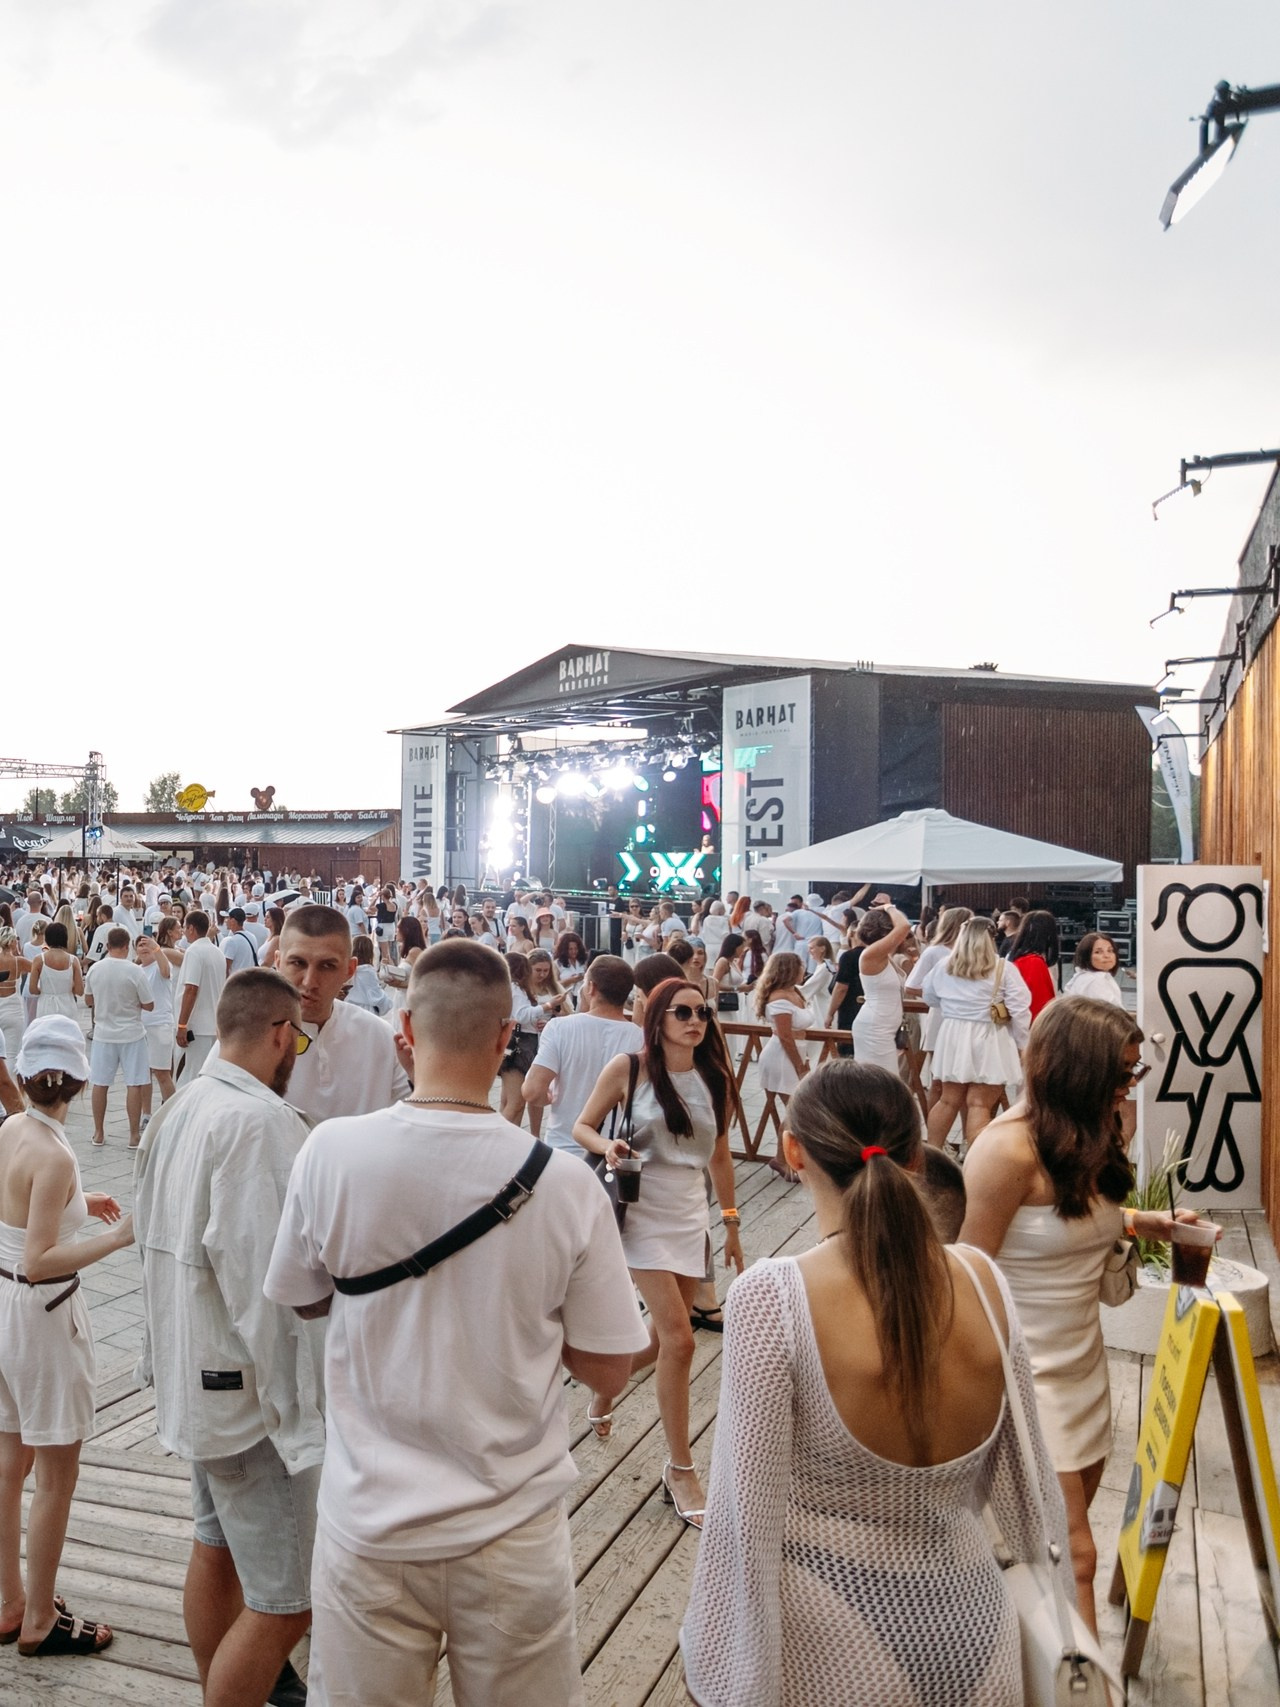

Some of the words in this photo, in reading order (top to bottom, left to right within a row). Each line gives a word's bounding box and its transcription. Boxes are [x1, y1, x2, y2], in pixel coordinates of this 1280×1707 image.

[559, 651, 611, 680] BARHAT
[735, 702, 796, 730] BARHAT
[408, 745, 440, 762] BARHAT
[412, 783, 433, 878] WHITE
